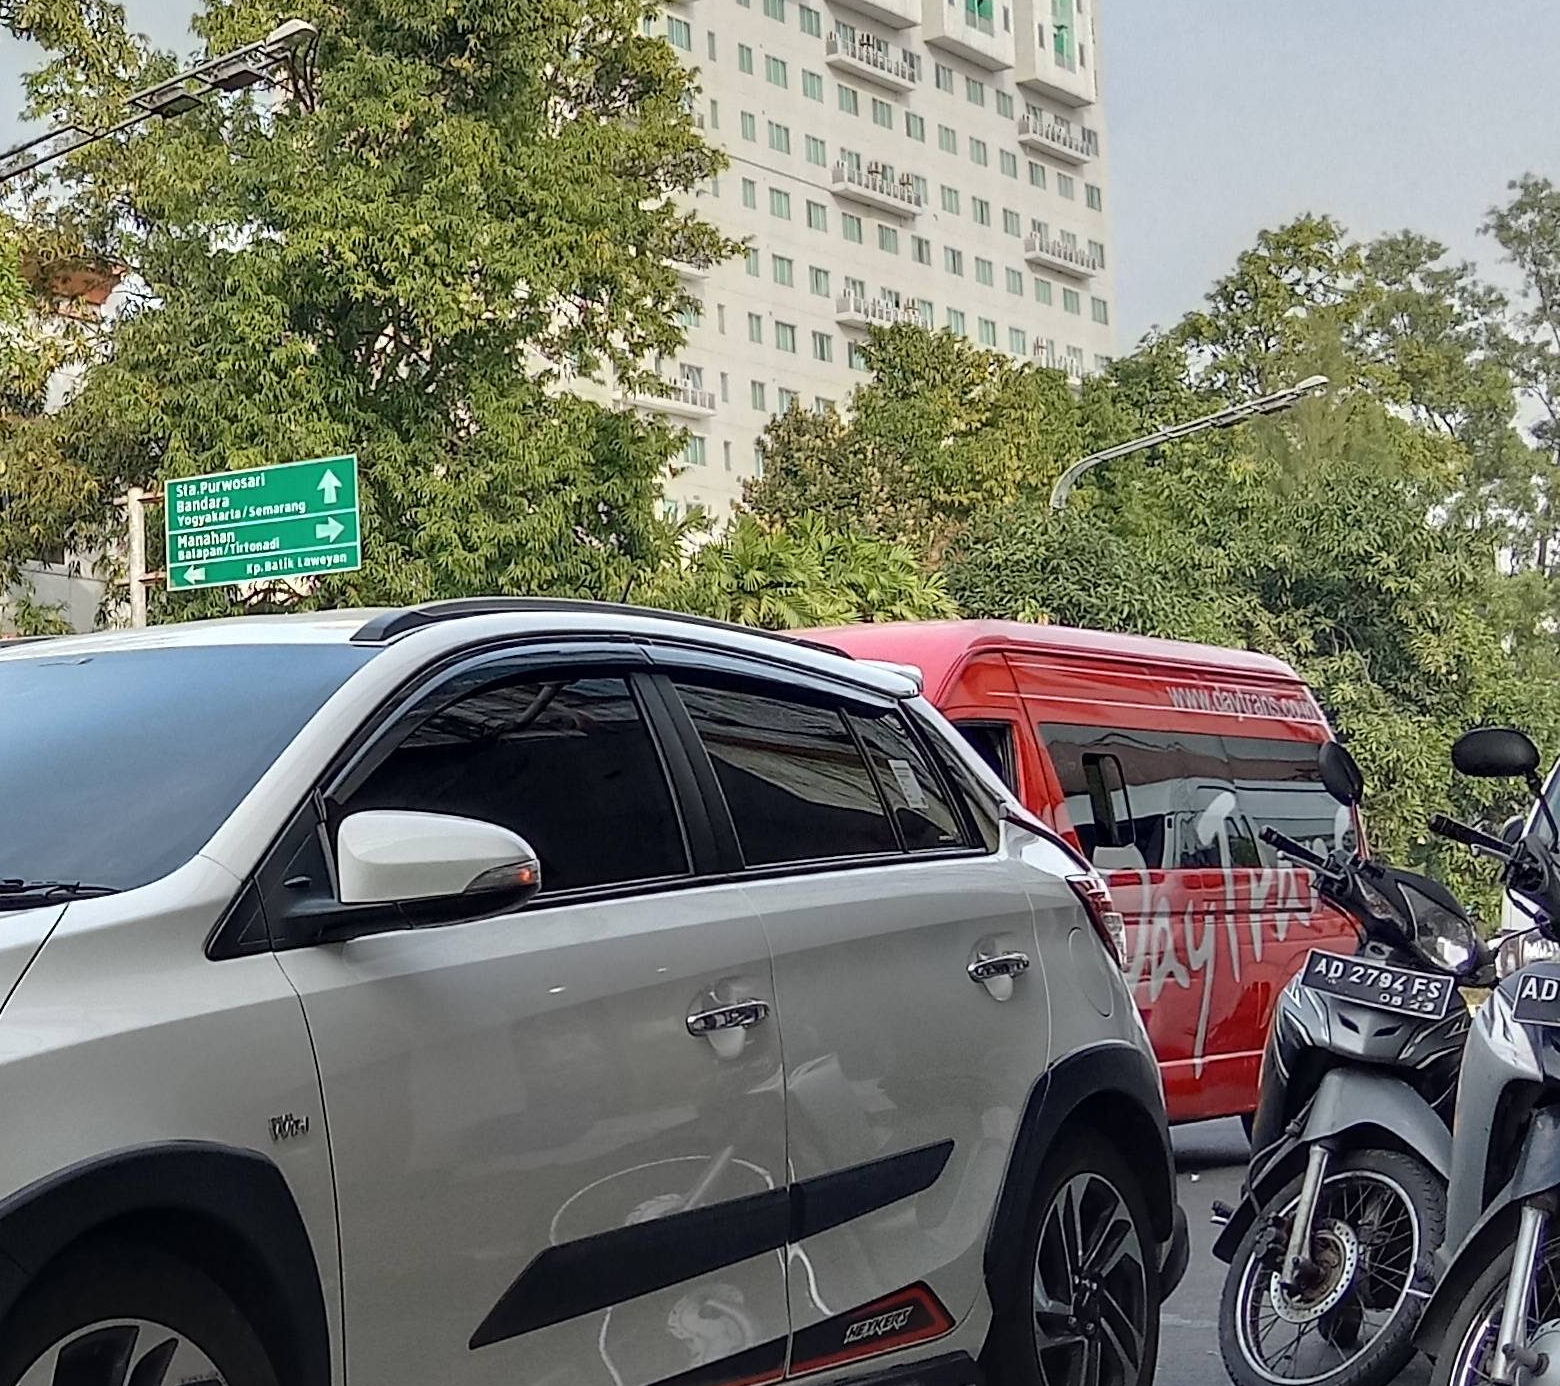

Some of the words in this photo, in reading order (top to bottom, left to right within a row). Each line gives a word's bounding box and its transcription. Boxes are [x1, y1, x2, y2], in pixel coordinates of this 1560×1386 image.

[176, 496, 230, 513] Bandara
[177, 532, 235, 548] Manahan
[178, 537, 280, 561] Balapan/Tirtonadi
[297, 553, 347, 568] Laweyan
[1315, 957, 1344, 979] AD
[1348, 965, 1405, 991] 2794
[1411, 979, 1442, 998] FS
[1520, 977, 1559, 1001] AD
[843, 1305, 914, 1344] HEYKERS
